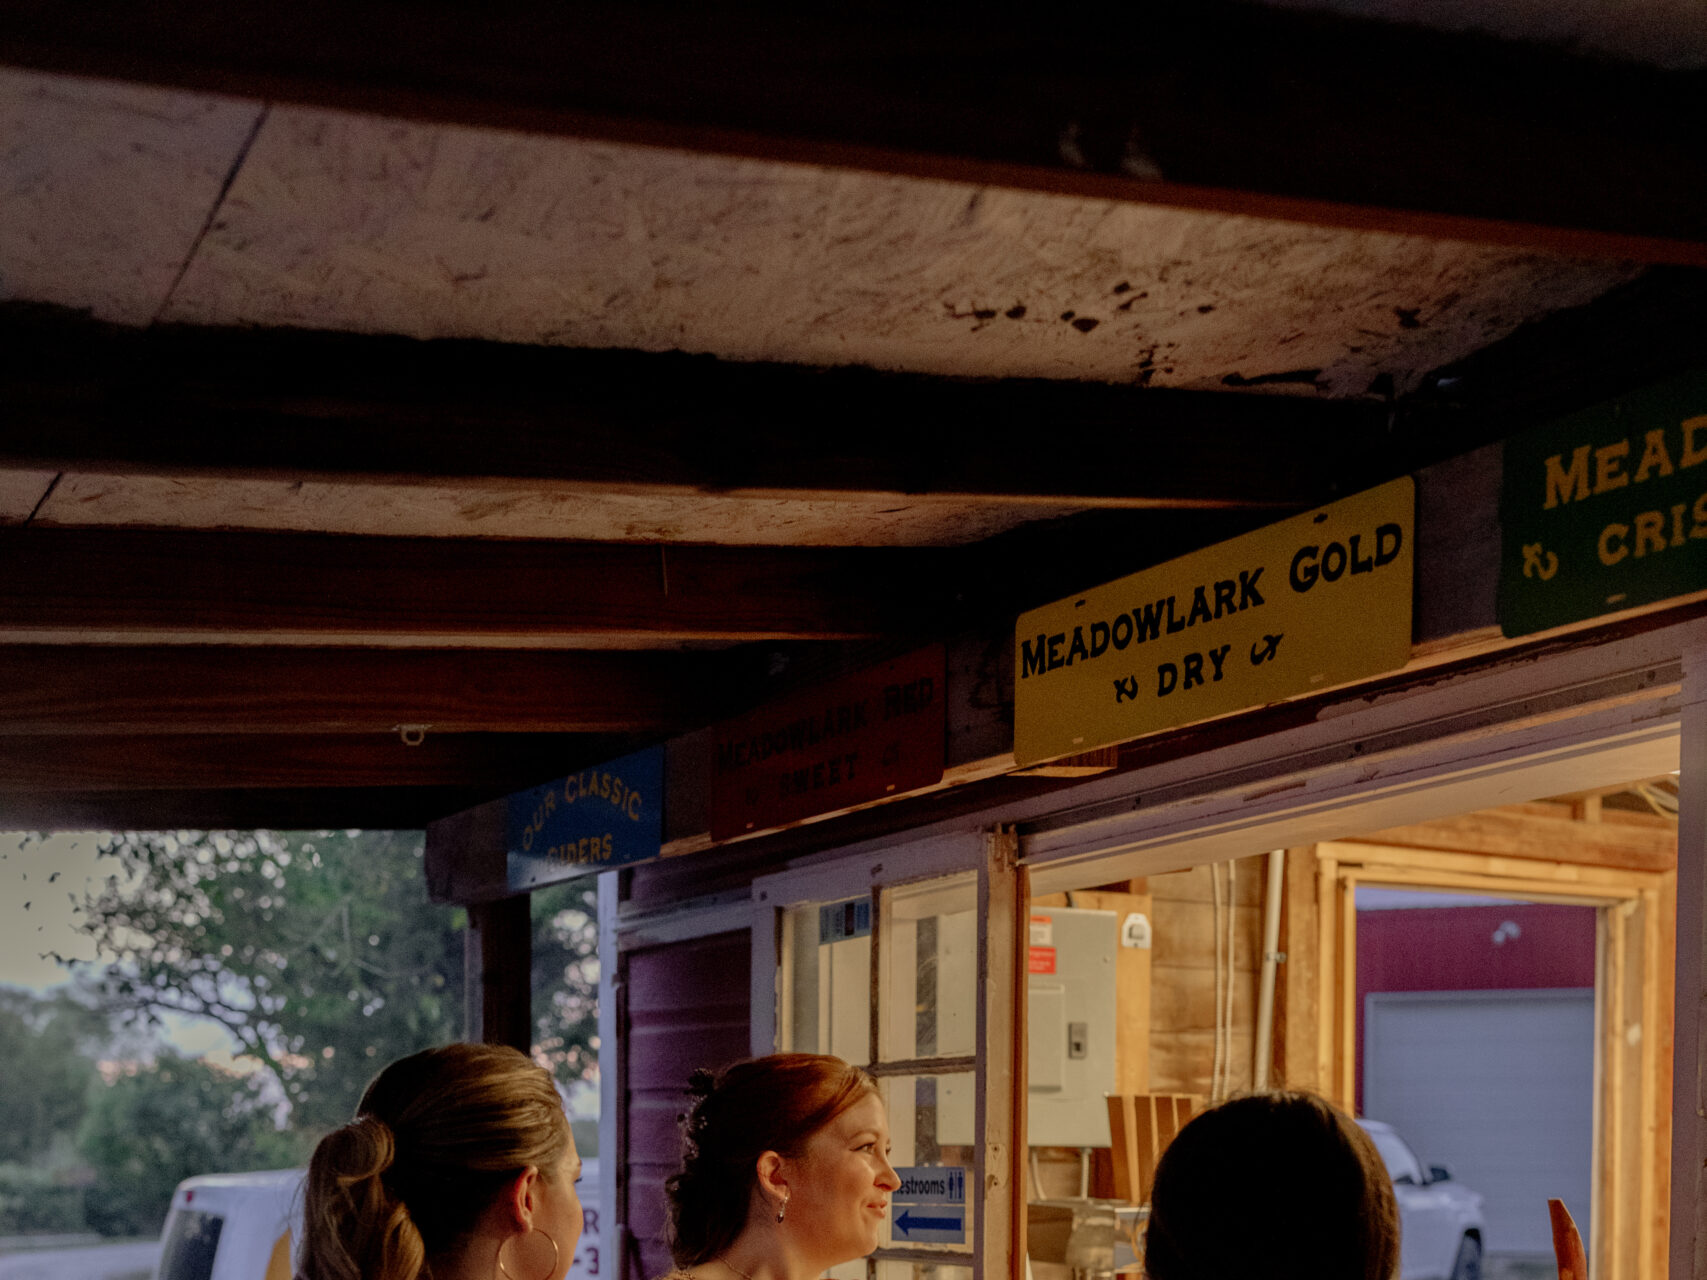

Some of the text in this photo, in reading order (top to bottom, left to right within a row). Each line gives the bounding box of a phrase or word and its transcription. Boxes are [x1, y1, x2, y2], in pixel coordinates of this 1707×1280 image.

[1020, 523, 1403, 679] MEADOWLARK GOLD
[1157, 644, 1231, 698] DRY
[718, 677, 934, 770] MEADOWLARK RED
[781, 752, 858, 794] SWEET
[522, 770, 643, 851] OUR CLASSIC
[897, 1176, 945, 1195] estrooms
